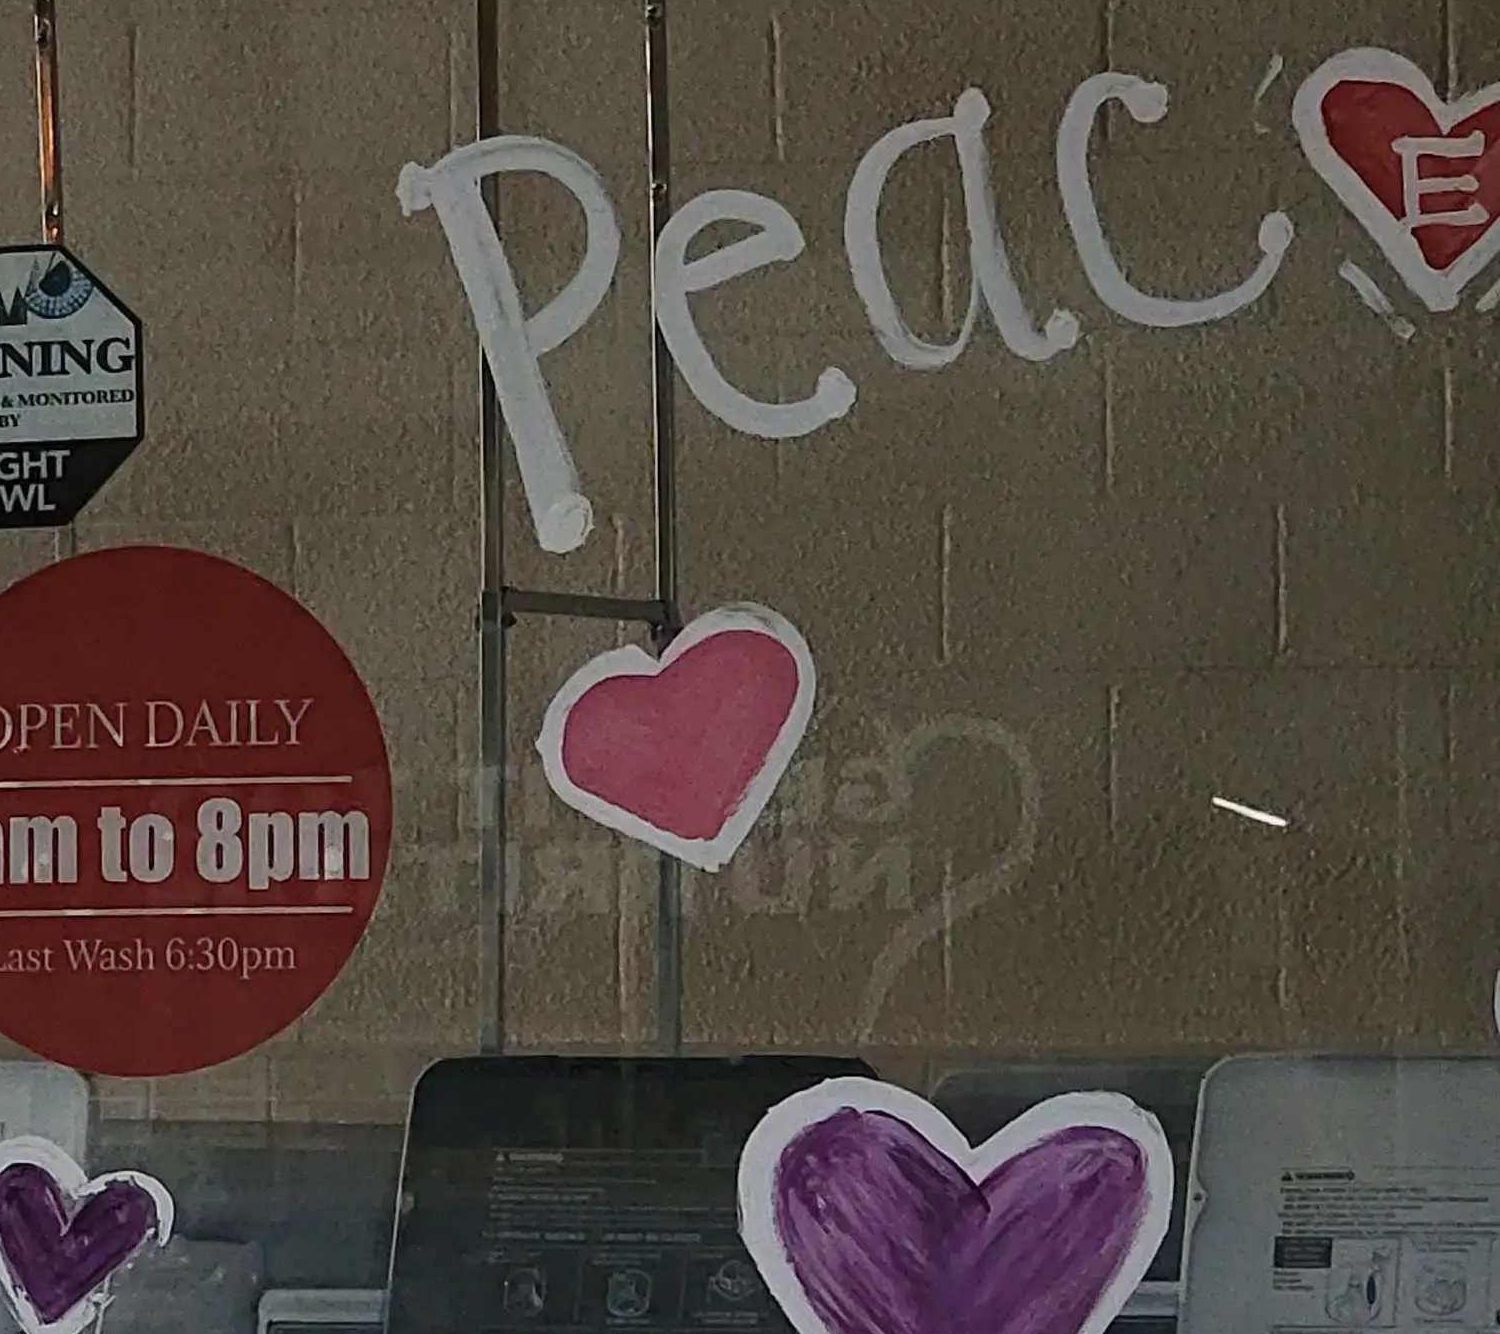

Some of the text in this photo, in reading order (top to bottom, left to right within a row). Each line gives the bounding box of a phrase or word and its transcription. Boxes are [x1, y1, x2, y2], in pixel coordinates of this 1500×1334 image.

[1, 395, 14, 408] &
[17, 389, 134, 408] MONITORED
[145, 698, 315, 748] DAILY
[97, 806, 175, 884] to
[196, 797, 370, 890] 8pm
[63, 938, 156, 972] Wash
[165, 937, 297, 981] 6:30pm
